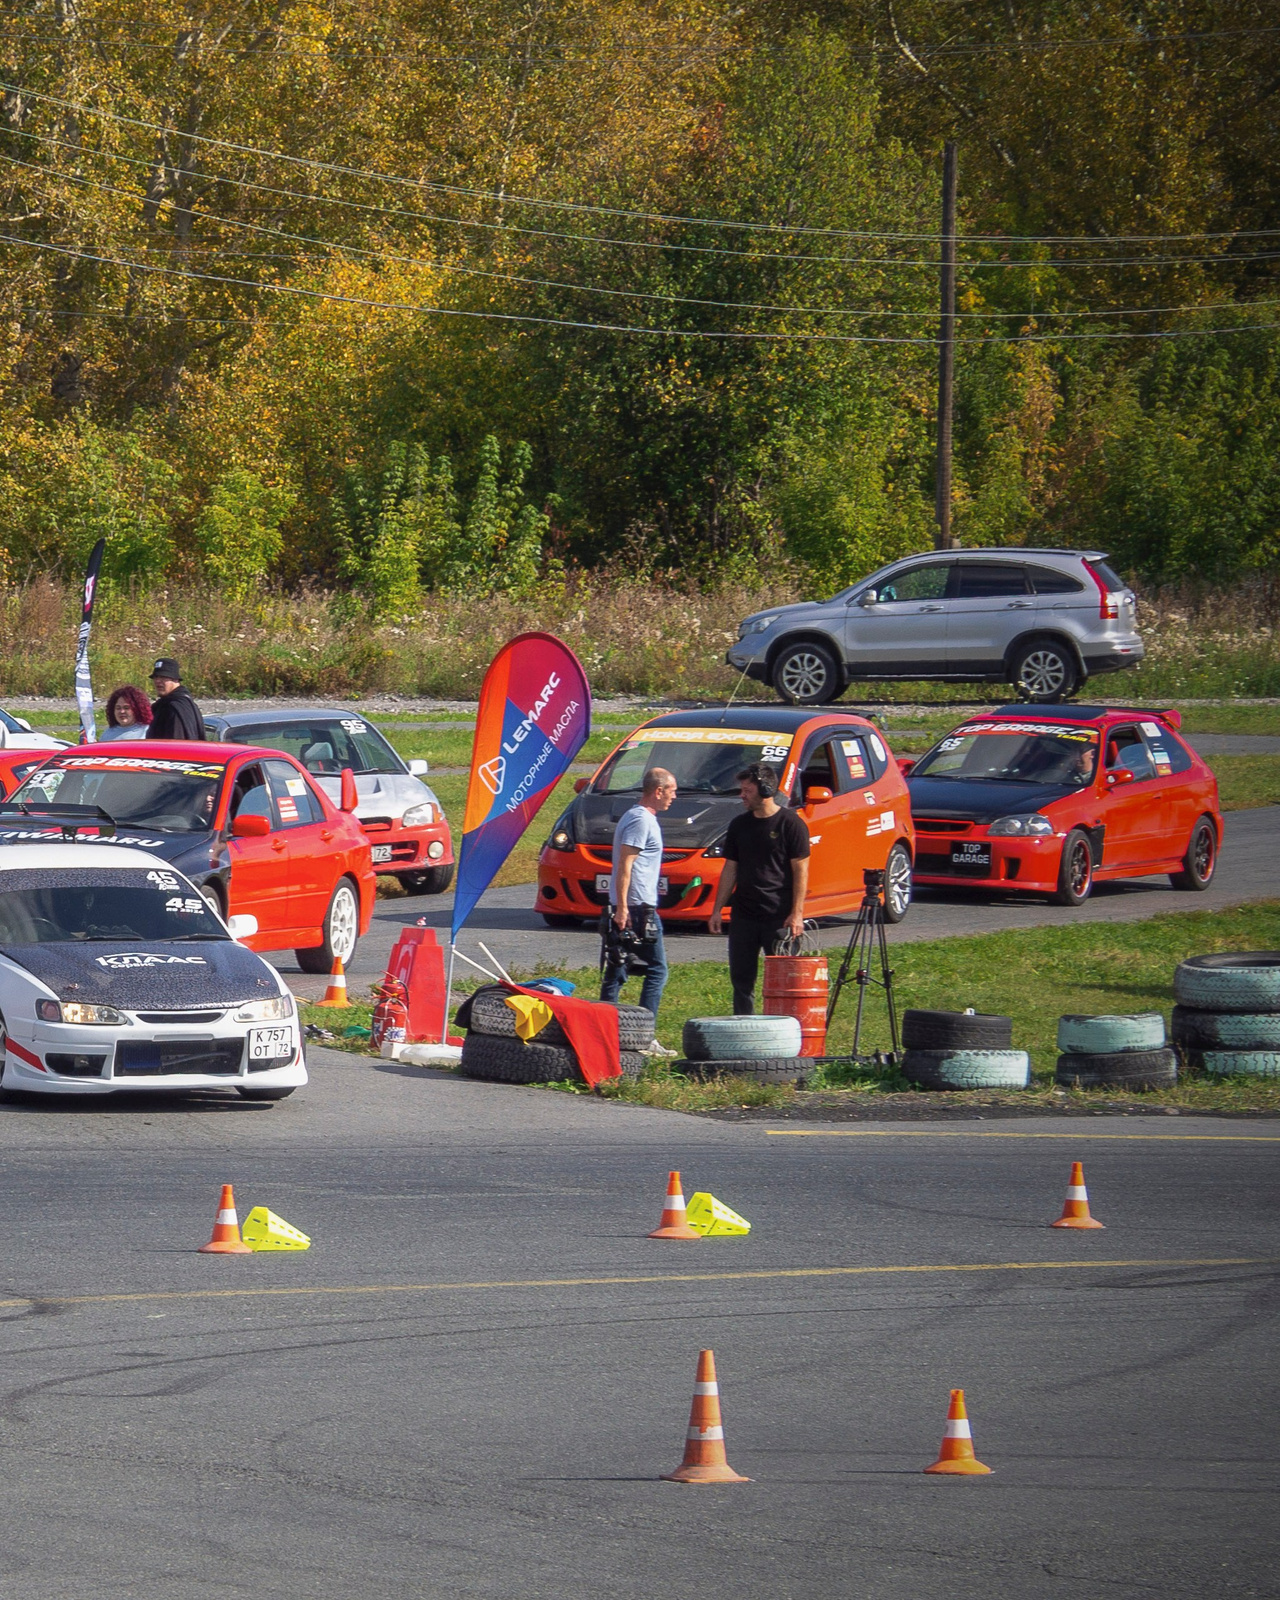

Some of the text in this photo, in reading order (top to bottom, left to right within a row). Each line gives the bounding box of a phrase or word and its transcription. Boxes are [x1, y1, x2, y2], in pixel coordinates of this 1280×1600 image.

[502, 671, 561, 754] LEMARC
[340, 720, 367, 730] 95
[955, 723, 1075, 736] TOP GARAGE
[641, 730, 702, 741] HONDA
[505, 700, 580, 813] МОТОРНЫЕ МАСЛА
[761, 745, 789, 757] 66
[58, 757, 202, 772] TOP GARAGE
[376, 847, 388, 857] 72
[962, 843, 981, 853] TOP
[952, 853, 990, 864] GARAGE
[146, 871, 178, 885] 45
[165, 897, 203, 910] 45
[95, 956, 208, 966] КЛААС
[267, 1029, 286, 1042] 757
[254, 1043, 289, 1057] ОТ 72
